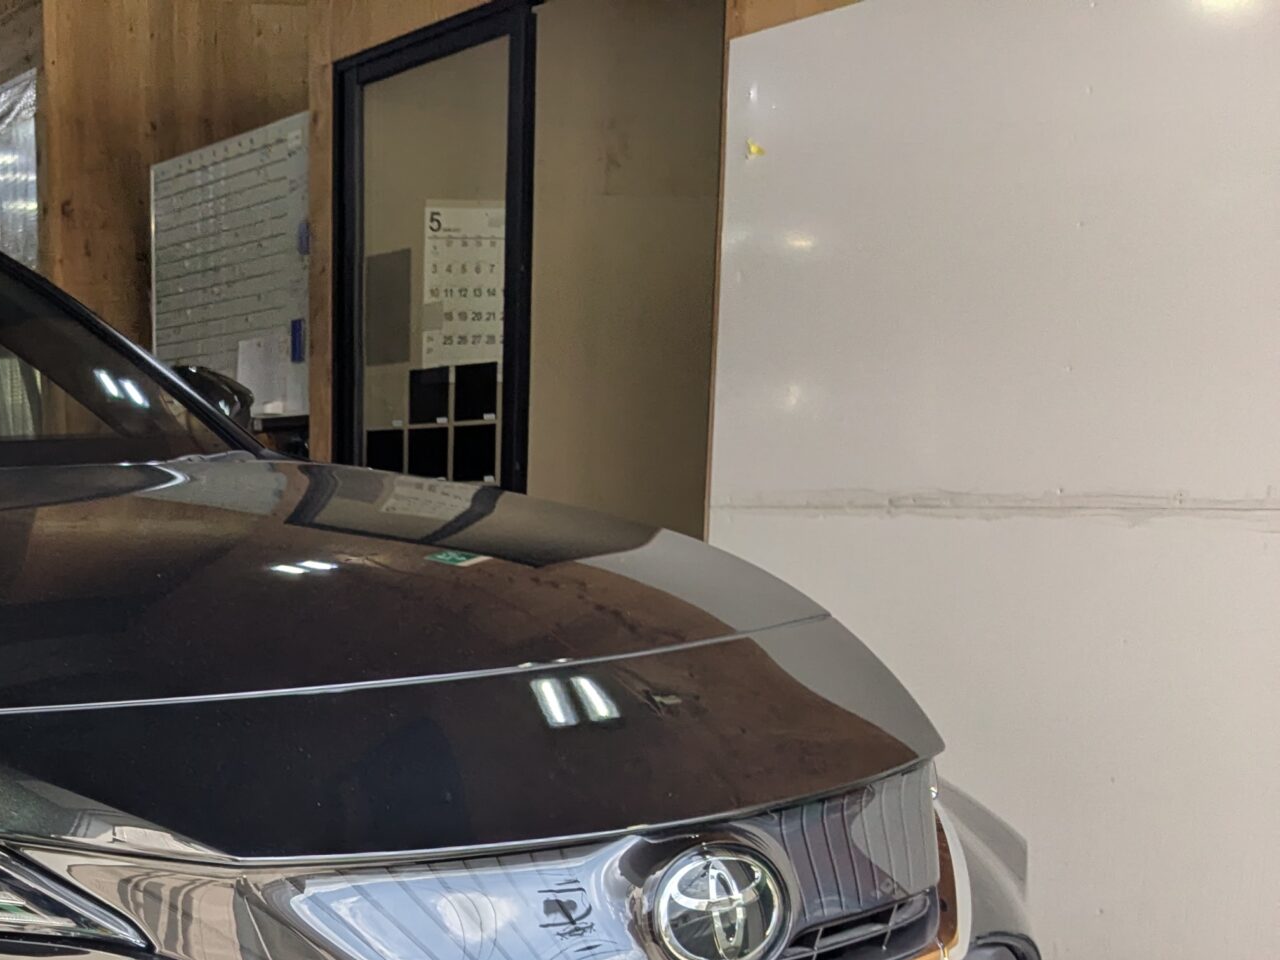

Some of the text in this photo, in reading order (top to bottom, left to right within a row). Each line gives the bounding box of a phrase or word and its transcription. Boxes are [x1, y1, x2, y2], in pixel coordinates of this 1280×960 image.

[429, 211, 442, 232] 5
[445, 263, 452, 274] 4
[489, 263, 496, 274] 7
[444, 287, 454, 298] 11
[458, 287, 468, 298] 12
[472, 287, 482, 298] 13
[486, 287, 496, 297] 14
[471, 311, 482, 322] 20
[485, 311, 496, 321] 21
